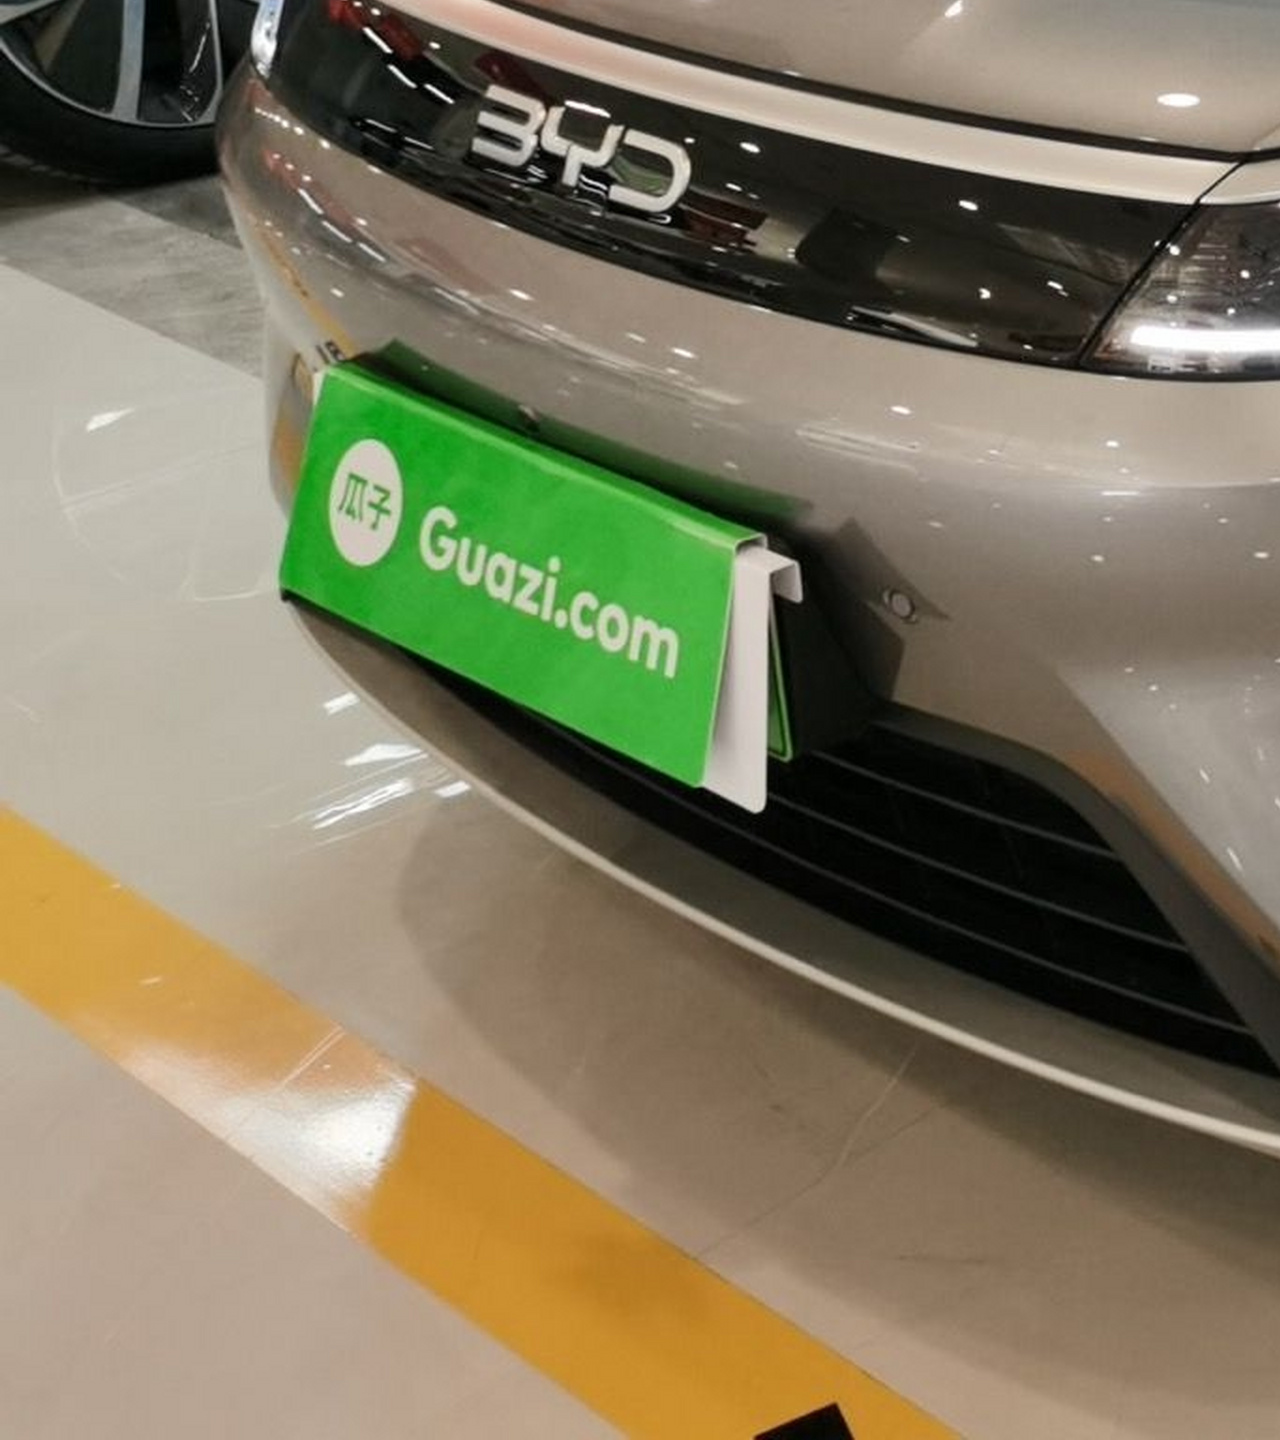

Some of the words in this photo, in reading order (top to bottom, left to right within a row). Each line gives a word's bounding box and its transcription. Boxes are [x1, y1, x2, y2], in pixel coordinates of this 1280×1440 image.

[471, 84, 692, 213] BYD
[338, 472, 392, 531] 瓜子
[419, 505, 680, 679] Guazi.com
